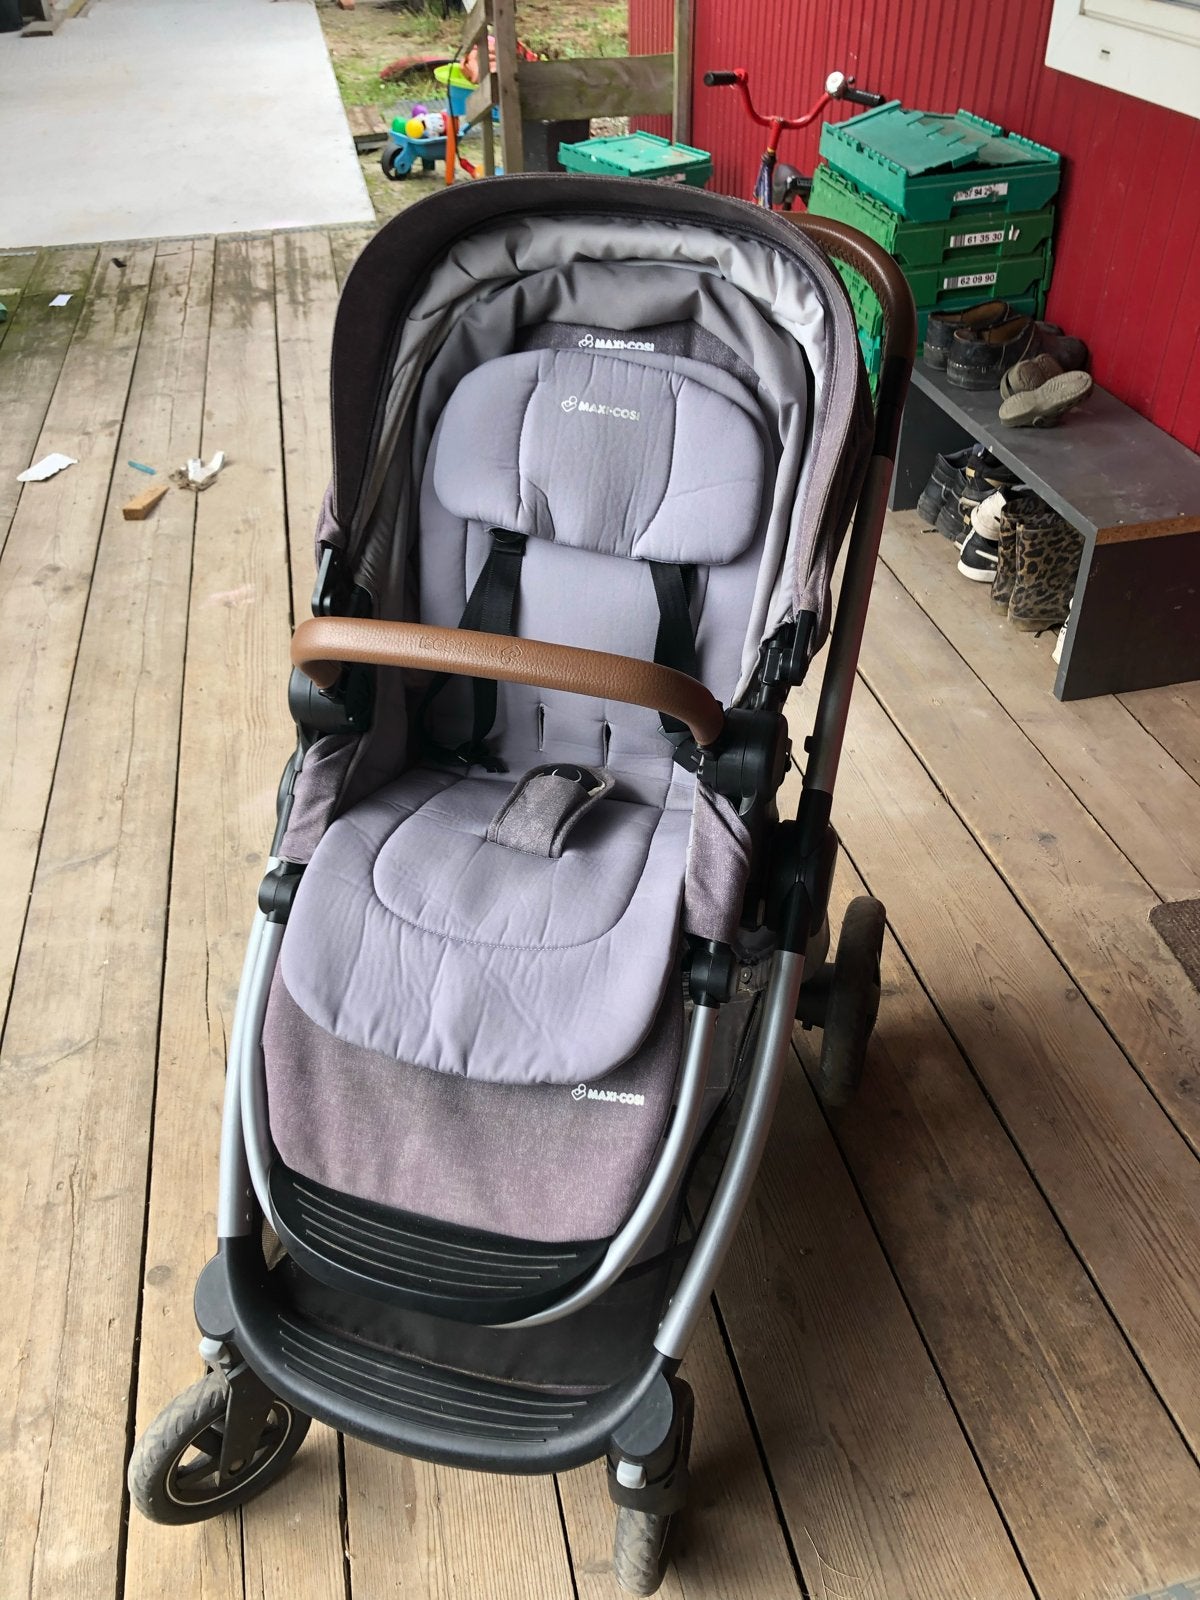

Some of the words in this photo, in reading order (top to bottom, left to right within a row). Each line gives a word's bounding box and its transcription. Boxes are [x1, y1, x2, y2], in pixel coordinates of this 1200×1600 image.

[967, 235, 977, 244] 61
[980, 234, 990, 243] 35
[992, 232, 1003, 241] 30
[960, 276, 970, 285] 62
[972, 275, 983, 283] 09
[984, 274, 995, 282] 90
